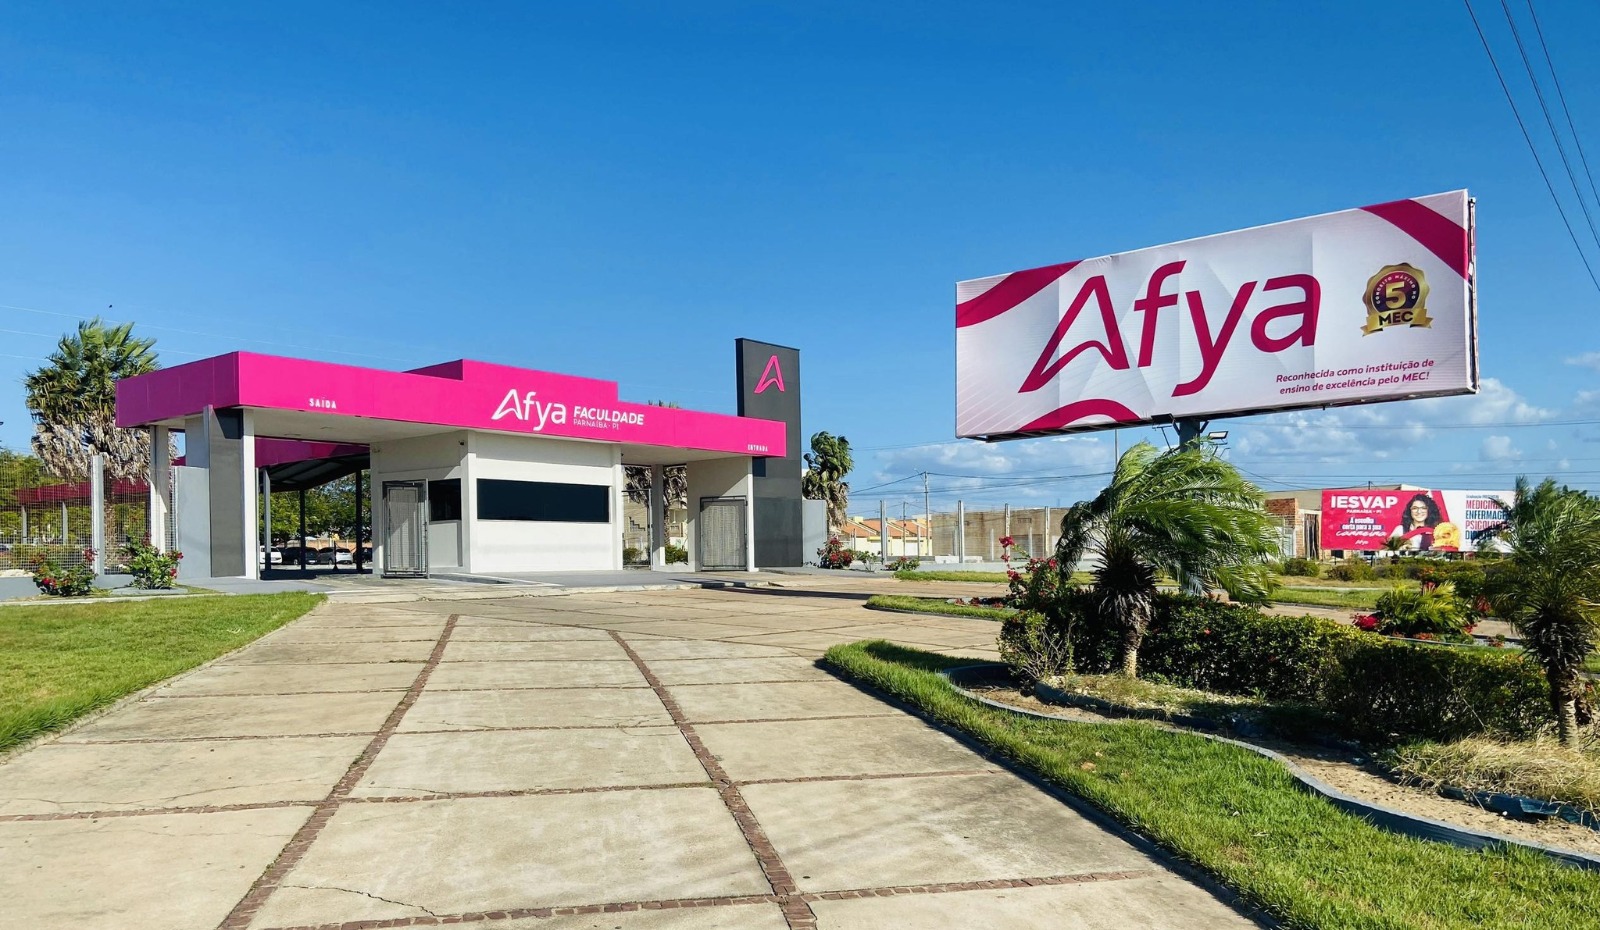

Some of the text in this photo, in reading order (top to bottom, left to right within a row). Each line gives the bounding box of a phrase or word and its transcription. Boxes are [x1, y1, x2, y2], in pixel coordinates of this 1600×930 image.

[1385, 281, 1407, 309] 5
[1018, 260, 1322, 397] Afya
[1378, 311, 1414, 326] MEC
[1276, 358, 1434, 383] Reconhecida como instituição de
[1279, 371, 1430, 395] ensino de excelência pelo MEC!
[309, 396, 337, 409] SAÍDA
[491, 388, 566, 431] Afya
[573, 405, 645, 426] FACULDADE
[573, 418, 608, 429] PARNAÍBA
[612, 422, 619, 430] PI
[747, 442, 769, 452] ENTRADA
[1330, 495, 1398, 509] IESVAP
